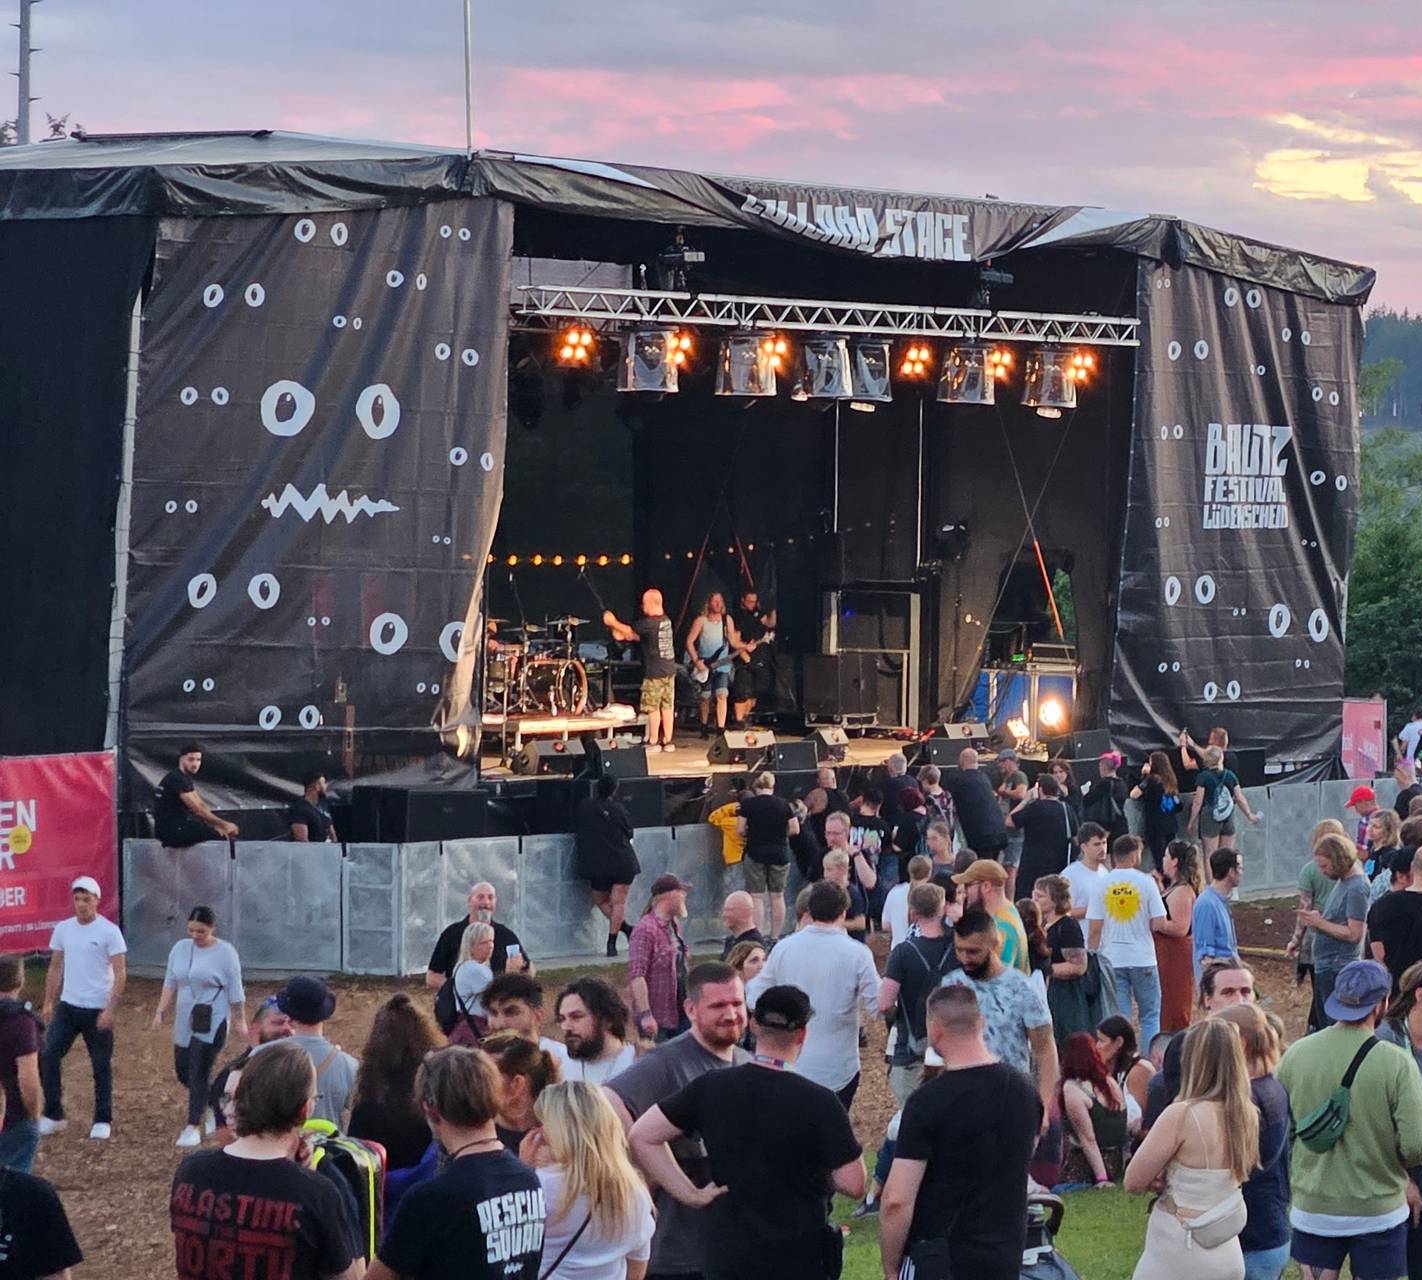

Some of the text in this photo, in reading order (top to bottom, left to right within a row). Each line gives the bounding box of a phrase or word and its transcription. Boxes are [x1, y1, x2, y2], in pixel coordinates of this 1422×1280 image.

[873, 208, 972, 262] STAGE
[1205, 423, 1293, 476] BAUTZ
[1204, 476, 1287, 502] FESTIVAL
